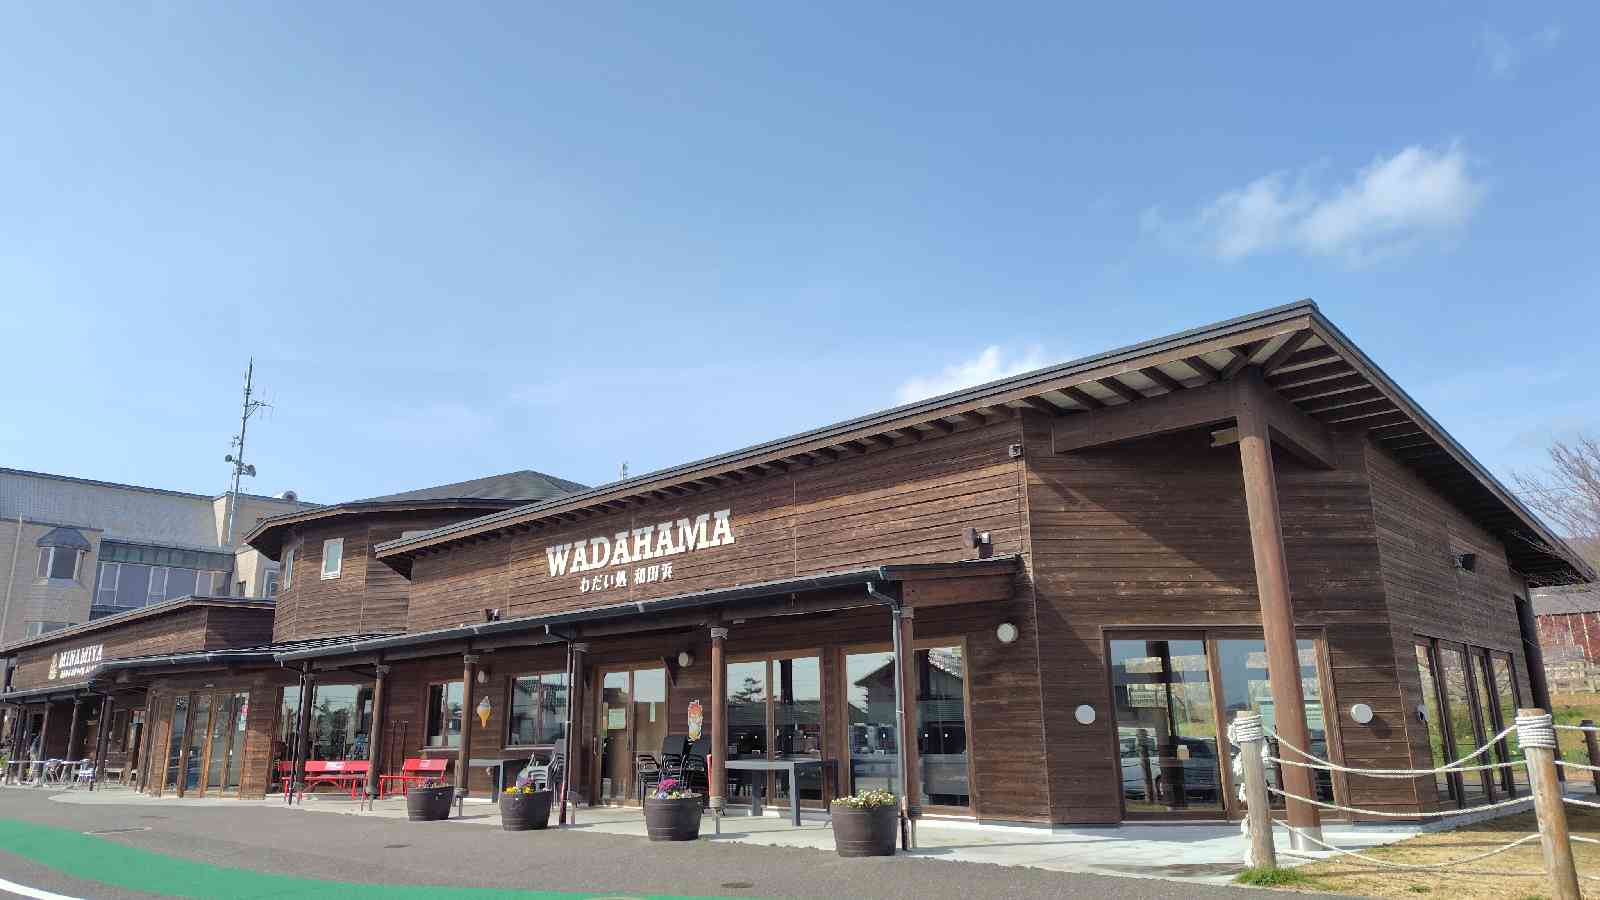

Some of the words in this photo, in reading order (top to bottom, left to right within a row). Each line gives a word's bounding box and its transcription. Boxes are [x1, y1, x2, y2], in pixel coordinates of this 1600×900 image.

[545, 508, 735, 577] WADAHAMA
[633, 562, 673, 585] 和田浜
[59, 643, 104, 668] MINAMIYA
